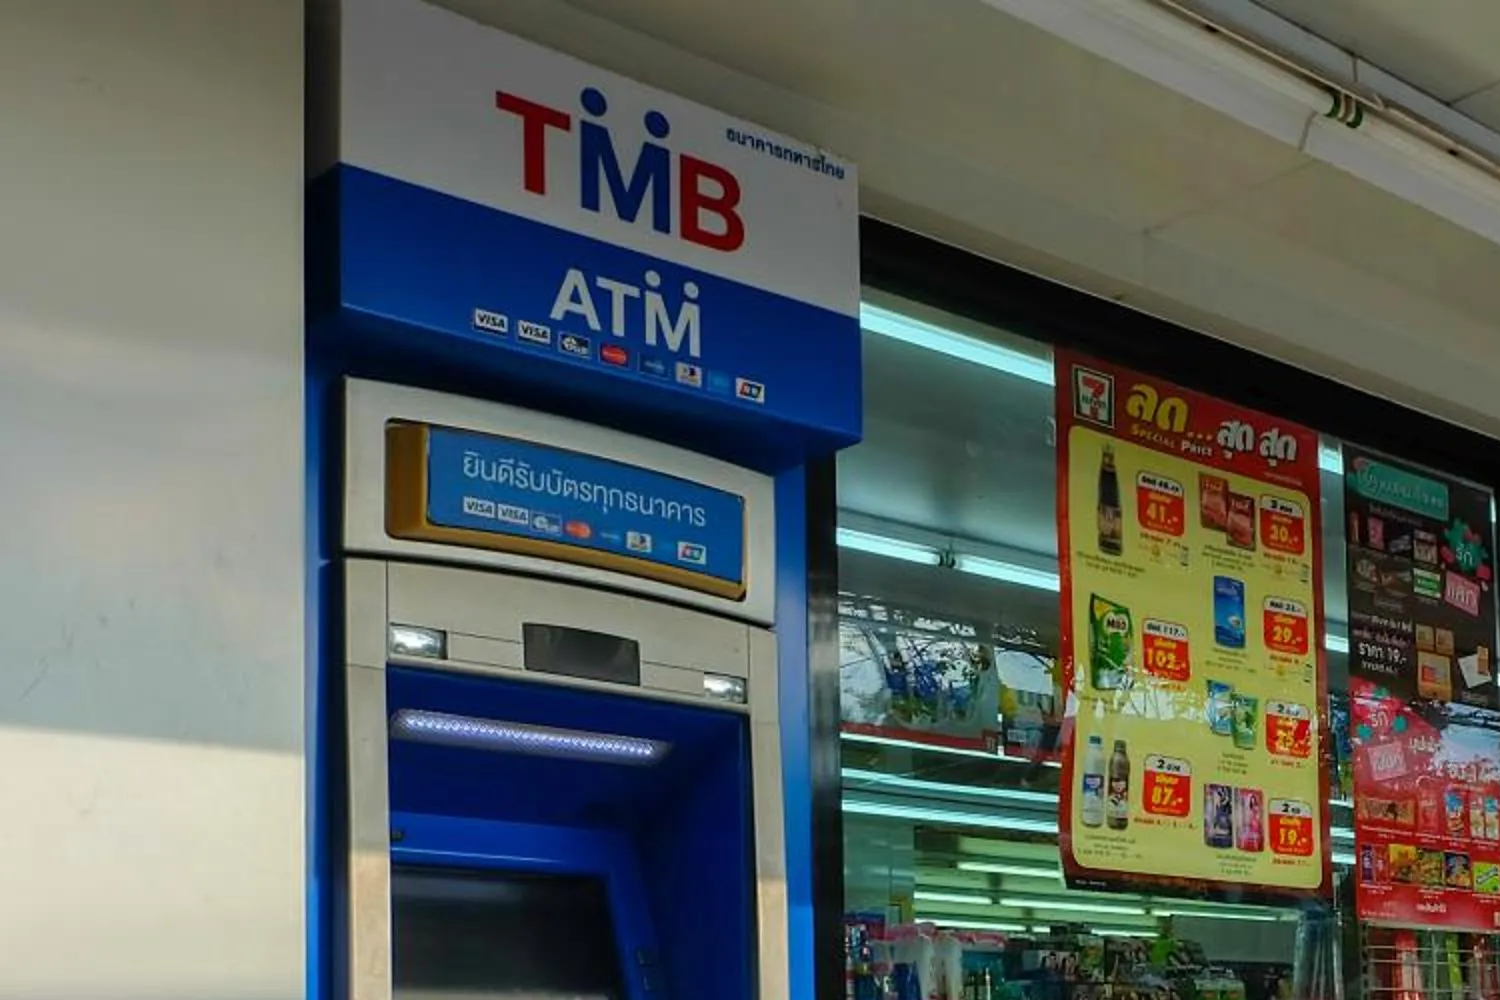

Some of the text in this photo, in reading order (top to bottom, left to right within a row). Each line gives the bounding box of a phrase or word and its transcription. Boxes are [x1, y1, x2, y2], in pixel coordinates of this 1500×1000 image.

[495, 86, 745, 253] TMB
[726, 127, 846, 180] ธนาคารทหารไทย
[476, 310, 549, 341] VISA VISA
[549, 268, 701, 358] ATM
[462, 451, 707, 527] ยินดีรับบัตรทุกธนาคาร
[465, 498, 494, 517] VISA
[501, 507, 528, 525] VISA
